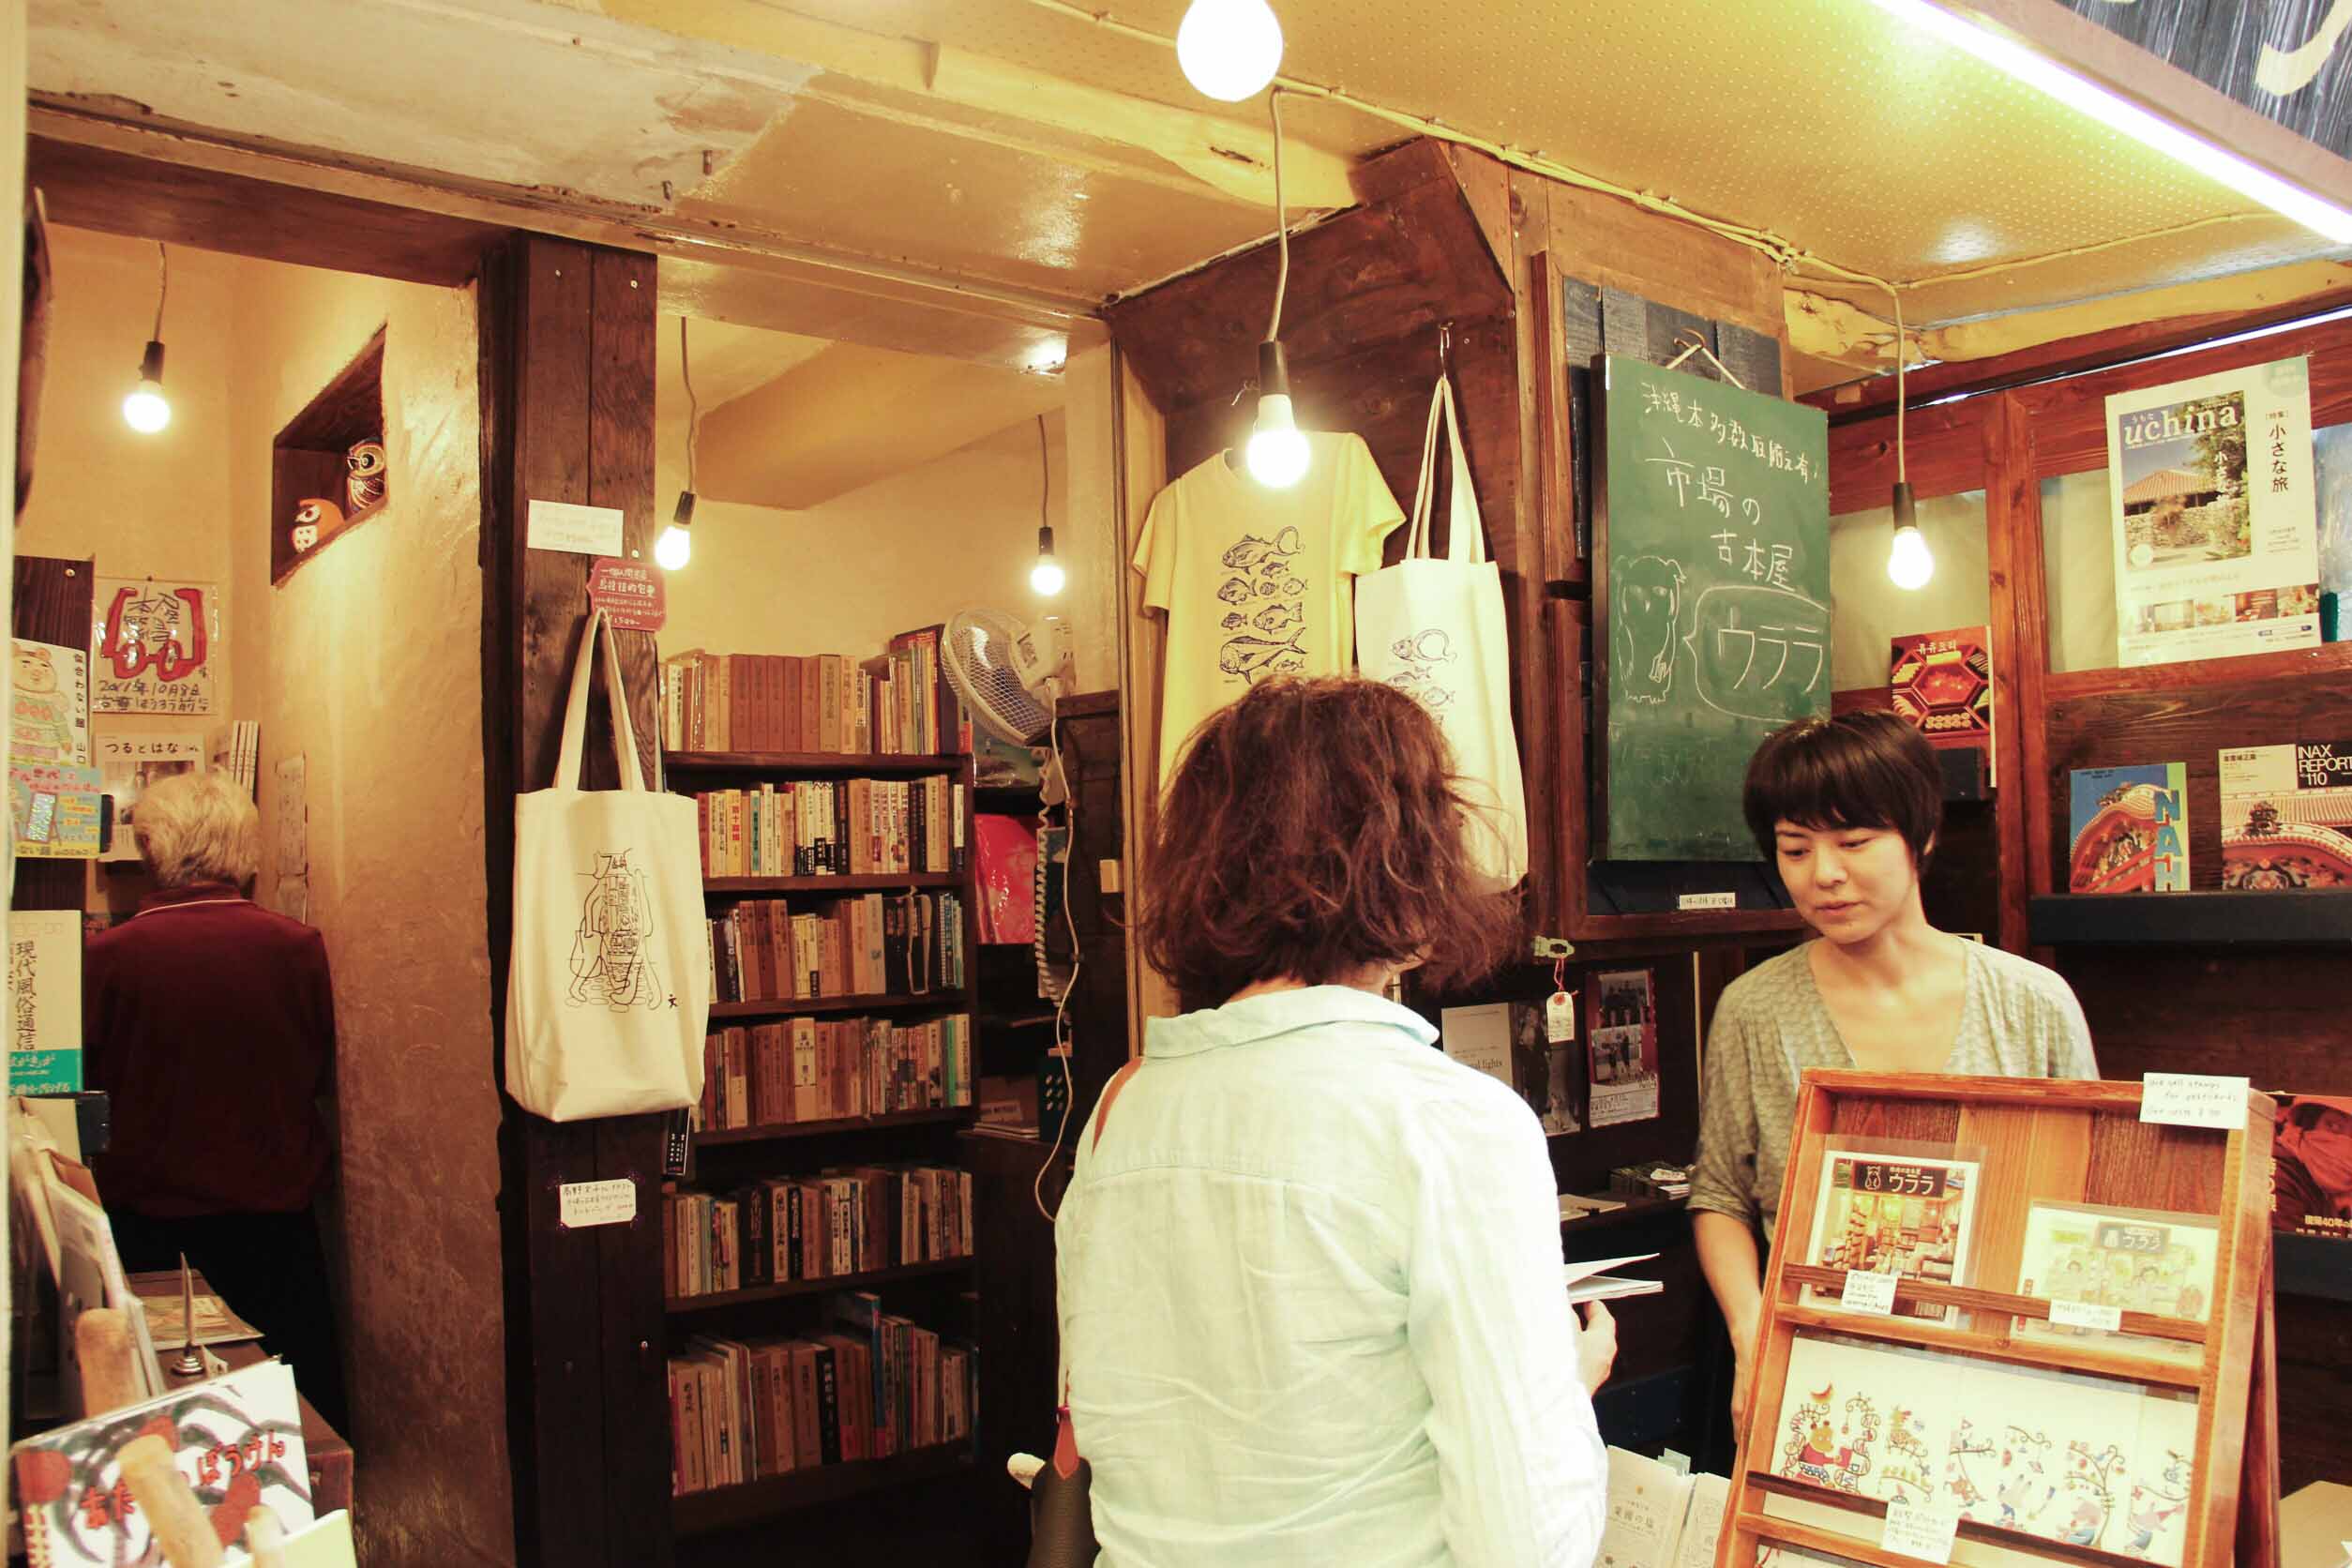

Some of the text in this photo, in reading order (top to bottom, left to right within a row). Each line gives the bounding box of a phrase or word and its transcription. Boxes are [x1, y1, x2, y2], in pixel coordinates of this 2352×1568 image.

[2123, 403, 2239, 445] uchina
[2268, 424, 2289, 493] 小さな旅
[1644, 437, 1761, 525] 市場の
[1710, 528, 1795, 591] 古本屋
[105, 742, 179, 754] つるとはな
[2298, 744, 2332, 760] INAX
[2308, 772, 2328, 787] 110
[1889, 1173, 1935, 1195] ウララ
